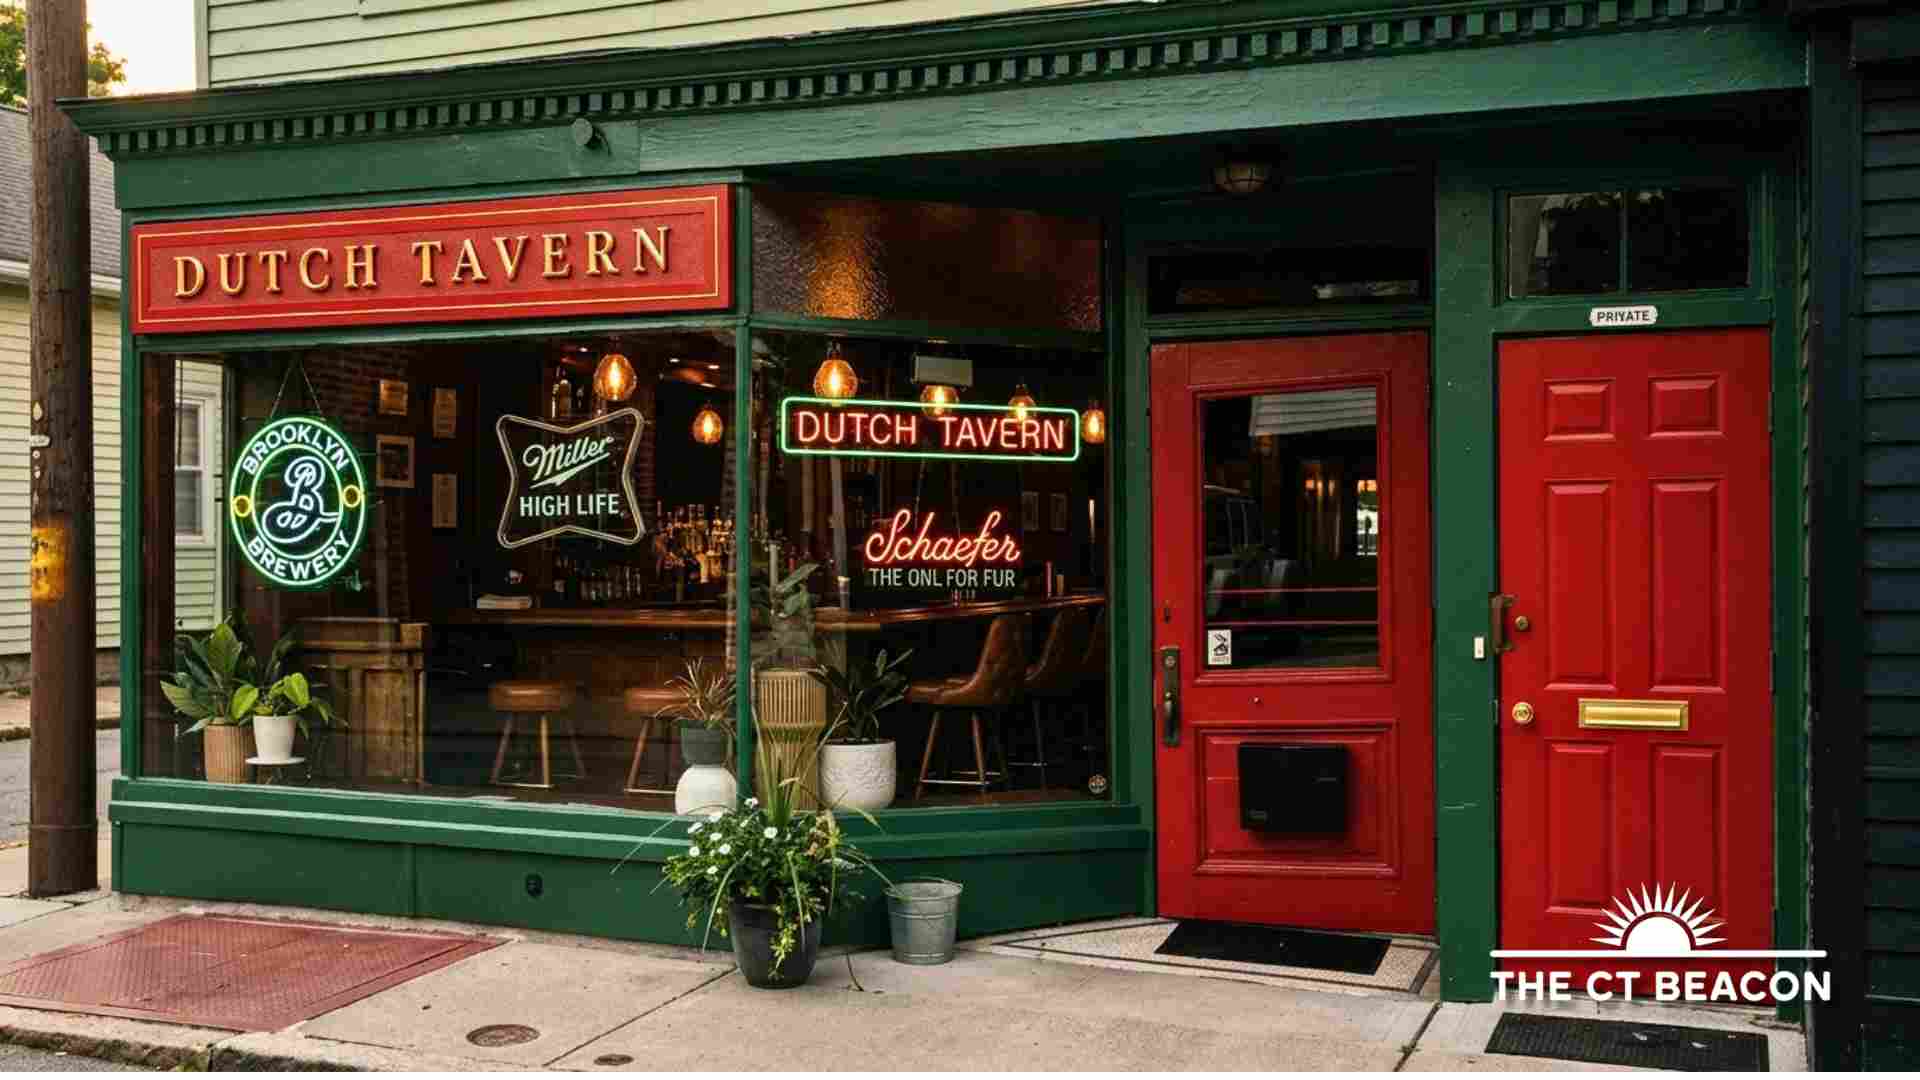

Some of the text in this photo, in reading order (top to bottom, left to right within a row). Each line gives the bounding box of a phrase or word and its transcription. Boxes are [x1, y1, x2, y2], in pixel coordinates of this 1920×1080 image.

[174, 225, 671, 298] DUTCH TAVERN
[242, 424, 350, 475] BROOKLYN
[797, 410, 1065, 449] DUTCH TAVERN
[522, 436, 615, 481] Miller
[519, 495, 570, 517] HIGH
[247, 529, 350, 580] BREWERY
[865, 508, 1022, 568] Schaefer
[868, 567, 1016, 588] THE ONL FOR FUR
